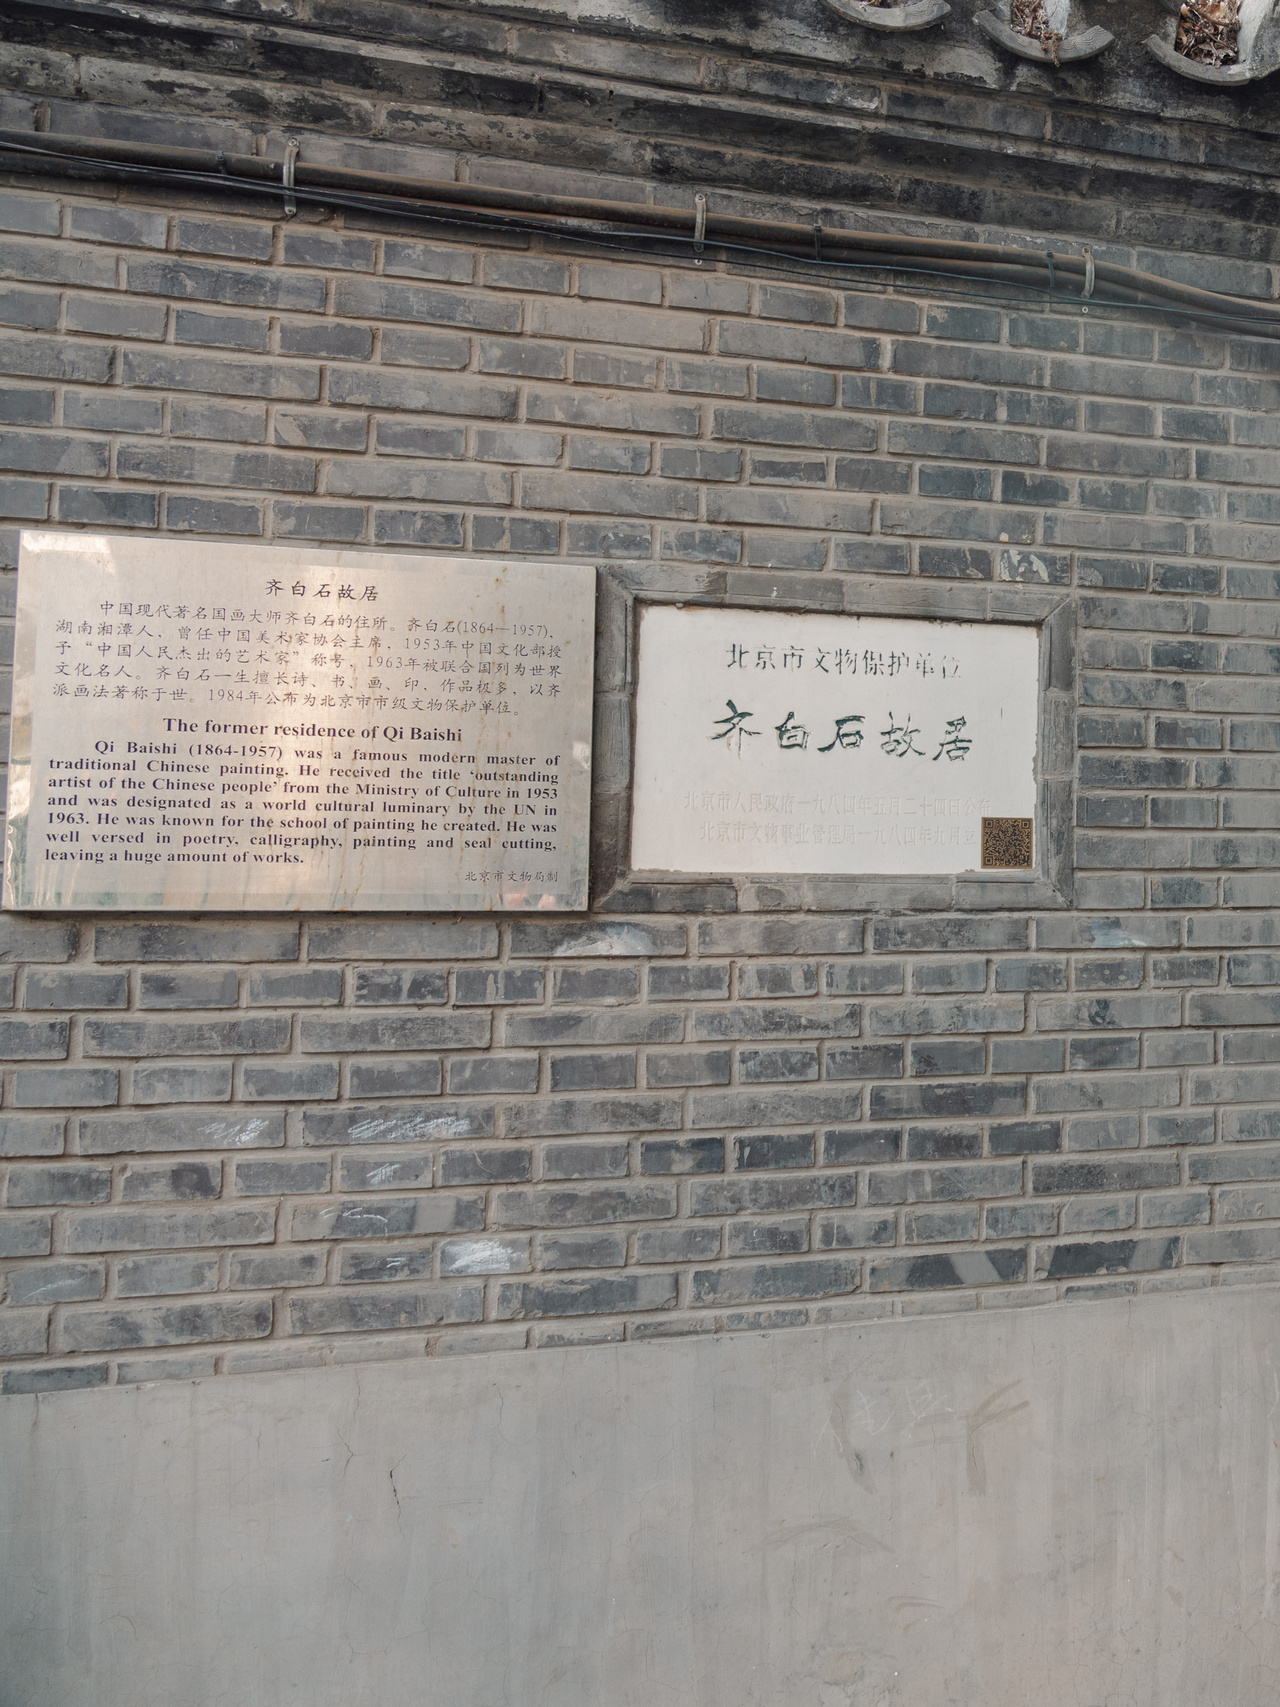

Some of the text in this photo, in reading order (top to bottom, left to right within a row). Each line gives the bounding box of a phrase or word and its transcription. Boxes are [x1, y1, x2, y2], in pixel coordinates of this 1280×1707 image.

[265, 579, 379, 601] 齐白石故居
[727, 643, 962, 680] 北京市文物保护单位
[163, 718, 462, 742] The former residence of Qi Baishi
[708, 699, 974, 762] 齐白石故居
[95, 740, 560, 766] Qi Baishi (1864-1957) was a famous modern master of
[49, 759, 136, 771] traditional
[147, 760, 210, 773] Chinese
[220, 764, 288, 778] painting.
[299, 764, 319, 776] He
[330, 766, 390, 778] received
[401, 768, 423, 779] the
[432, 769, 461, 780] title
[48, 777, 92, 788] artist
[99, 777, 116, 789] of
[122, 778, 145, 790] the
[152, 778, 215, 791] Chinese
[283, 781, 319, 794] from
[326, 783, 349, 794] the
[356, 783, 419, 798] Ministry
[426, 786, 440, 796] of
[446, 786, 500, 797] Culture
[507, 787, 519, 798] in
[527, 788, 558, 799] 1953
[48, 795, 557, 817] and was designated as a world cultural luminary by the UN in
[684, 791, 991, 818] 北京市人民政府一九八四年五月二十四日公布
[48, 813, 89, 825] 1963.
[97, 813, 119, 825] He
[126, 817, 155, 825] was
[162, 815, 214, 826] known
[222, 816, 244, 827] for
[250, 817, 274, 828] the
[280, 817, 327, 829] school
[334, 818, 349, 829] of
[353, 821, 415, 832] painting
[421, 821, 438, 831] he
[443, 822, 500, 831] created.
[506, 822, 526, 832] He
[46, 832, 556, 852] well versed in poetry, calligraphy, painting and seal cutting,
[45, 849, 304, 864] leaving a huge amount of works.
[465, 870, 558, 882] 北京市文物局制
